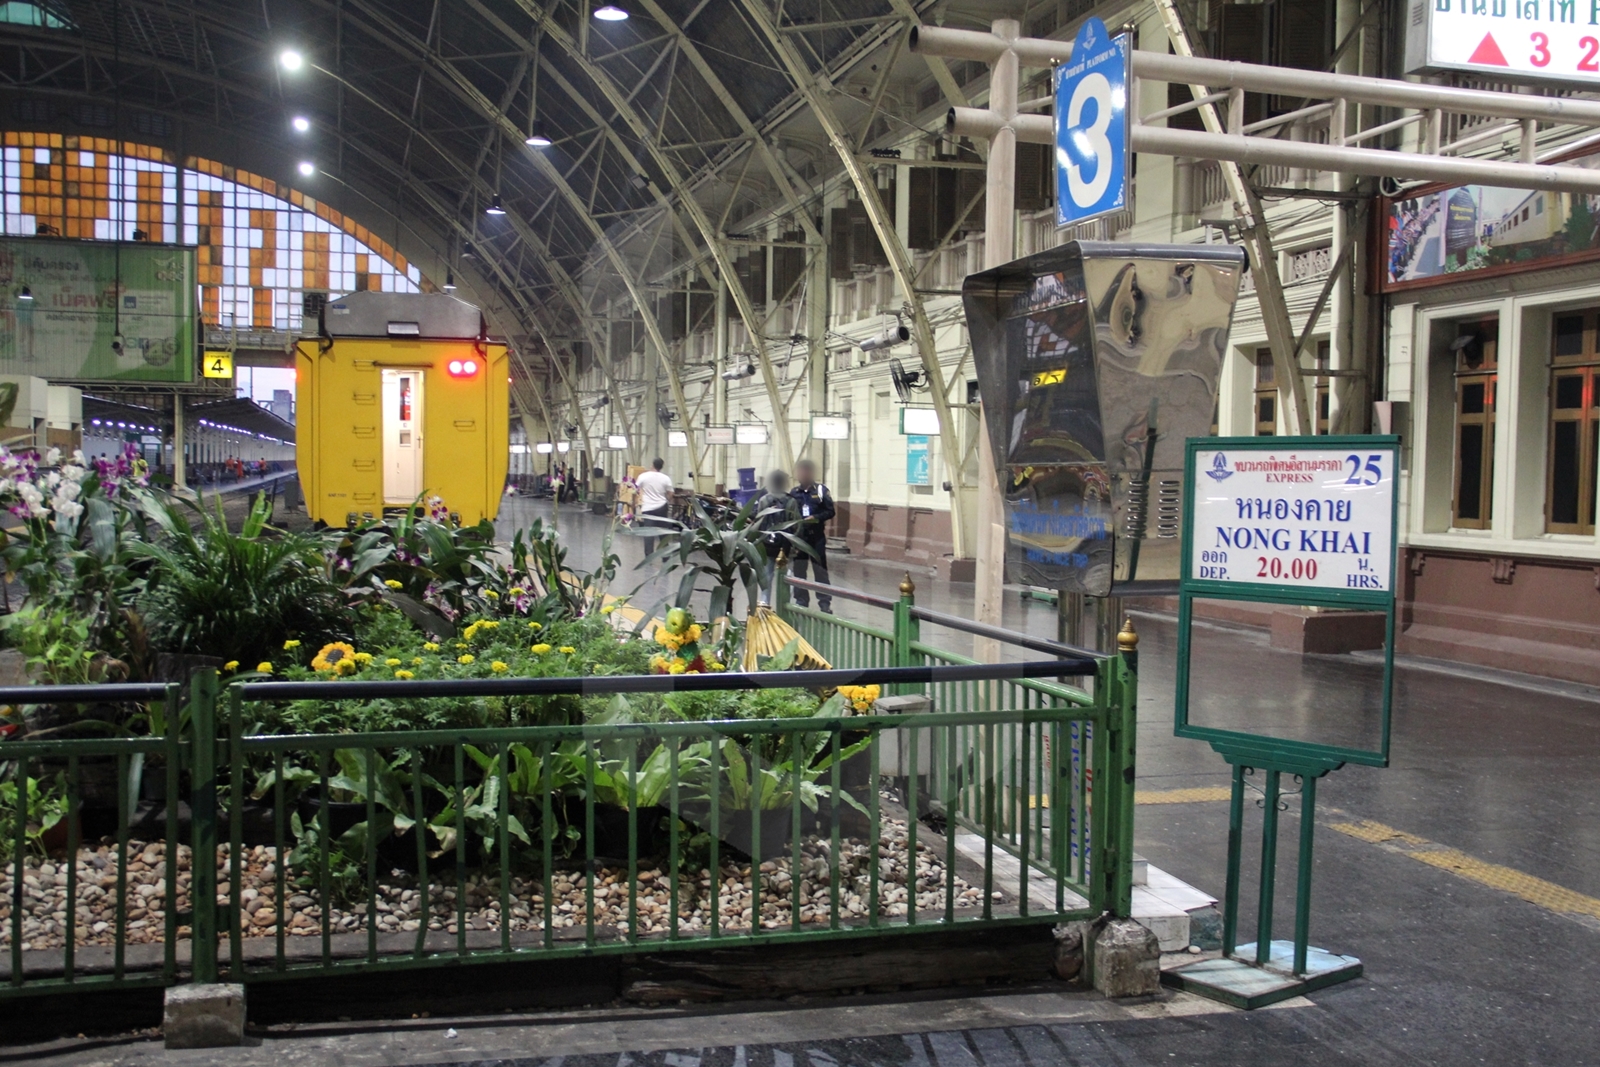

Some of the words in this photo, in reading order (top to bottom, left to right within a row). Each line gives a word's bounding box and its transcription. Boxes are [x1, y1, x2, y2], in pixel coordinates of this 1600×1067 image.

[1529, 31, 1551, 68] 3
[1576, 36, 1600, 72] 2
[1067, 72, 1113, 208] 3
[211, 358, 225, 374] 4
[1266, 473, 1314, 483] EXPRESS
[1344, 454, 1382, 487] 25
[1235, 497, 1352, 522] หนองคาย
[1215, 526, 1291, 551] NONG
[1299, 529, 1372, 555] KHAI
[1202, 549, 1228, 563] ออก
[1357, 557, 1374, 573] น.
[1200, 565, 1231, 580] DEP.
[1256, 555, 1318, 580] 20.00
[1346, 573, 1384, 589] HRS.
